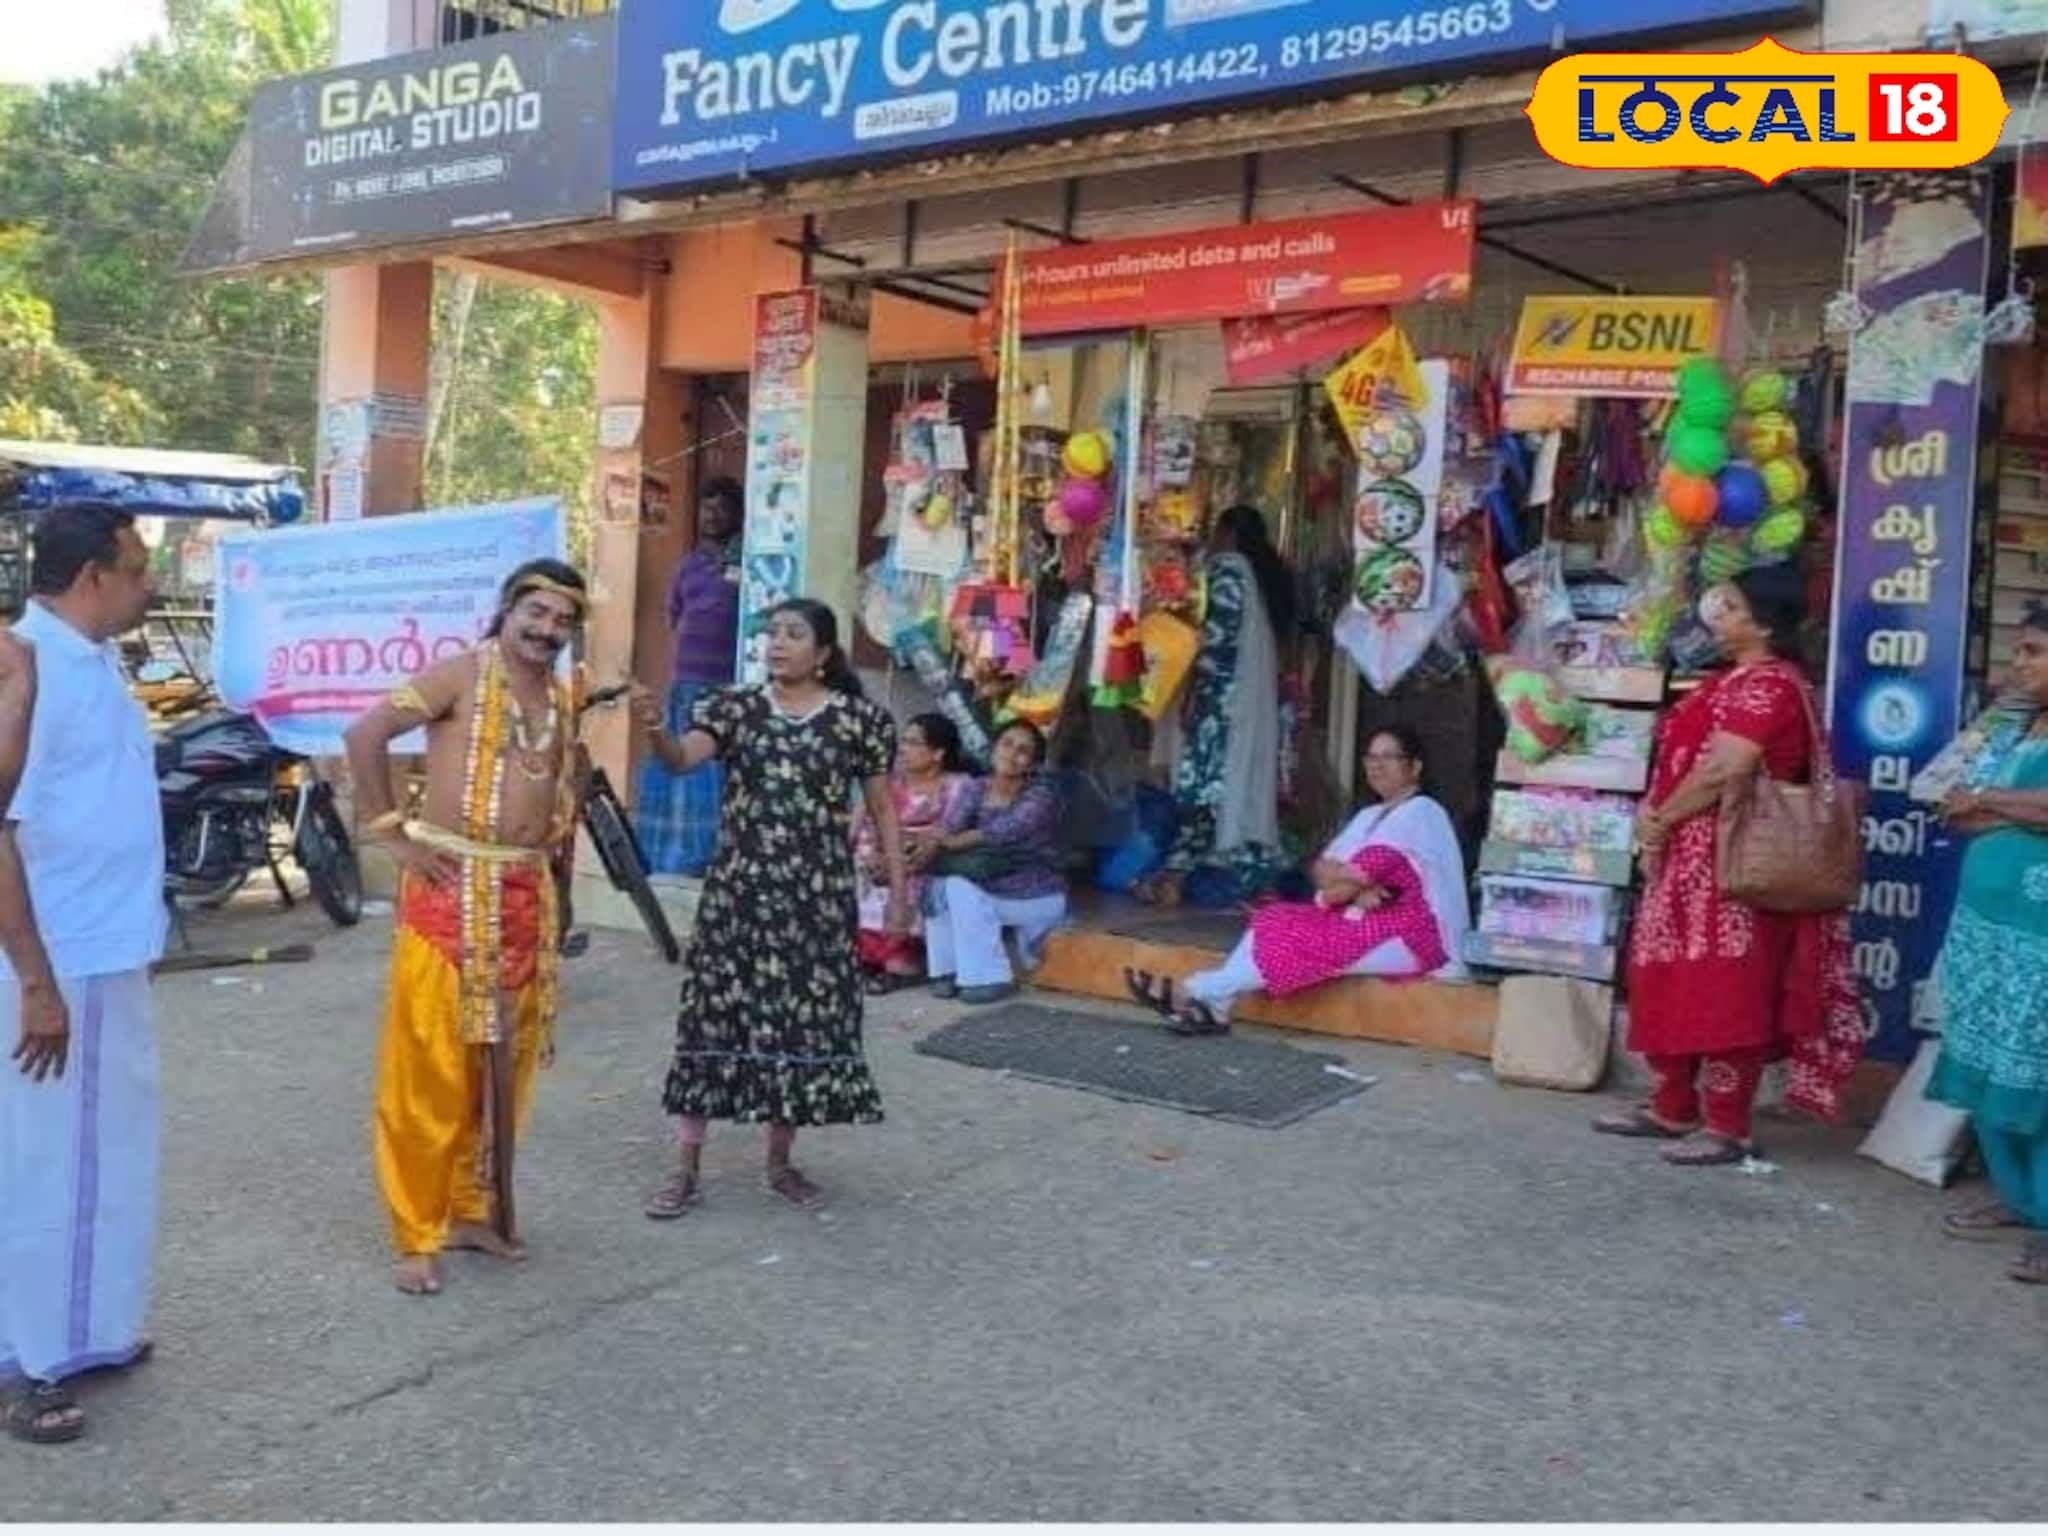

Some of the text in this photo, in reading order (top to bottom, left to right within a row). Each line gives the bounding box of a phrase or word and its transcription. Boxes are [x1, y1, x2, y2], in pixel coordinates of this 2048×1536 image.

[659, 34, 860, 126] Fancy
[881, 0, 1150, 87] Centre
[1280, 1, 1513, 69] 8129545663
[320, 53, 524, 129] GANGA
[304, 92, 541, 167] DIGITAL STUDIO
[1093, 249, 1186, 279] unlimited
[1240, 236, 1281, 262] and
[1285, 231, 1336, 257] calls
[1589, 312, 1702, 353] BSNL
